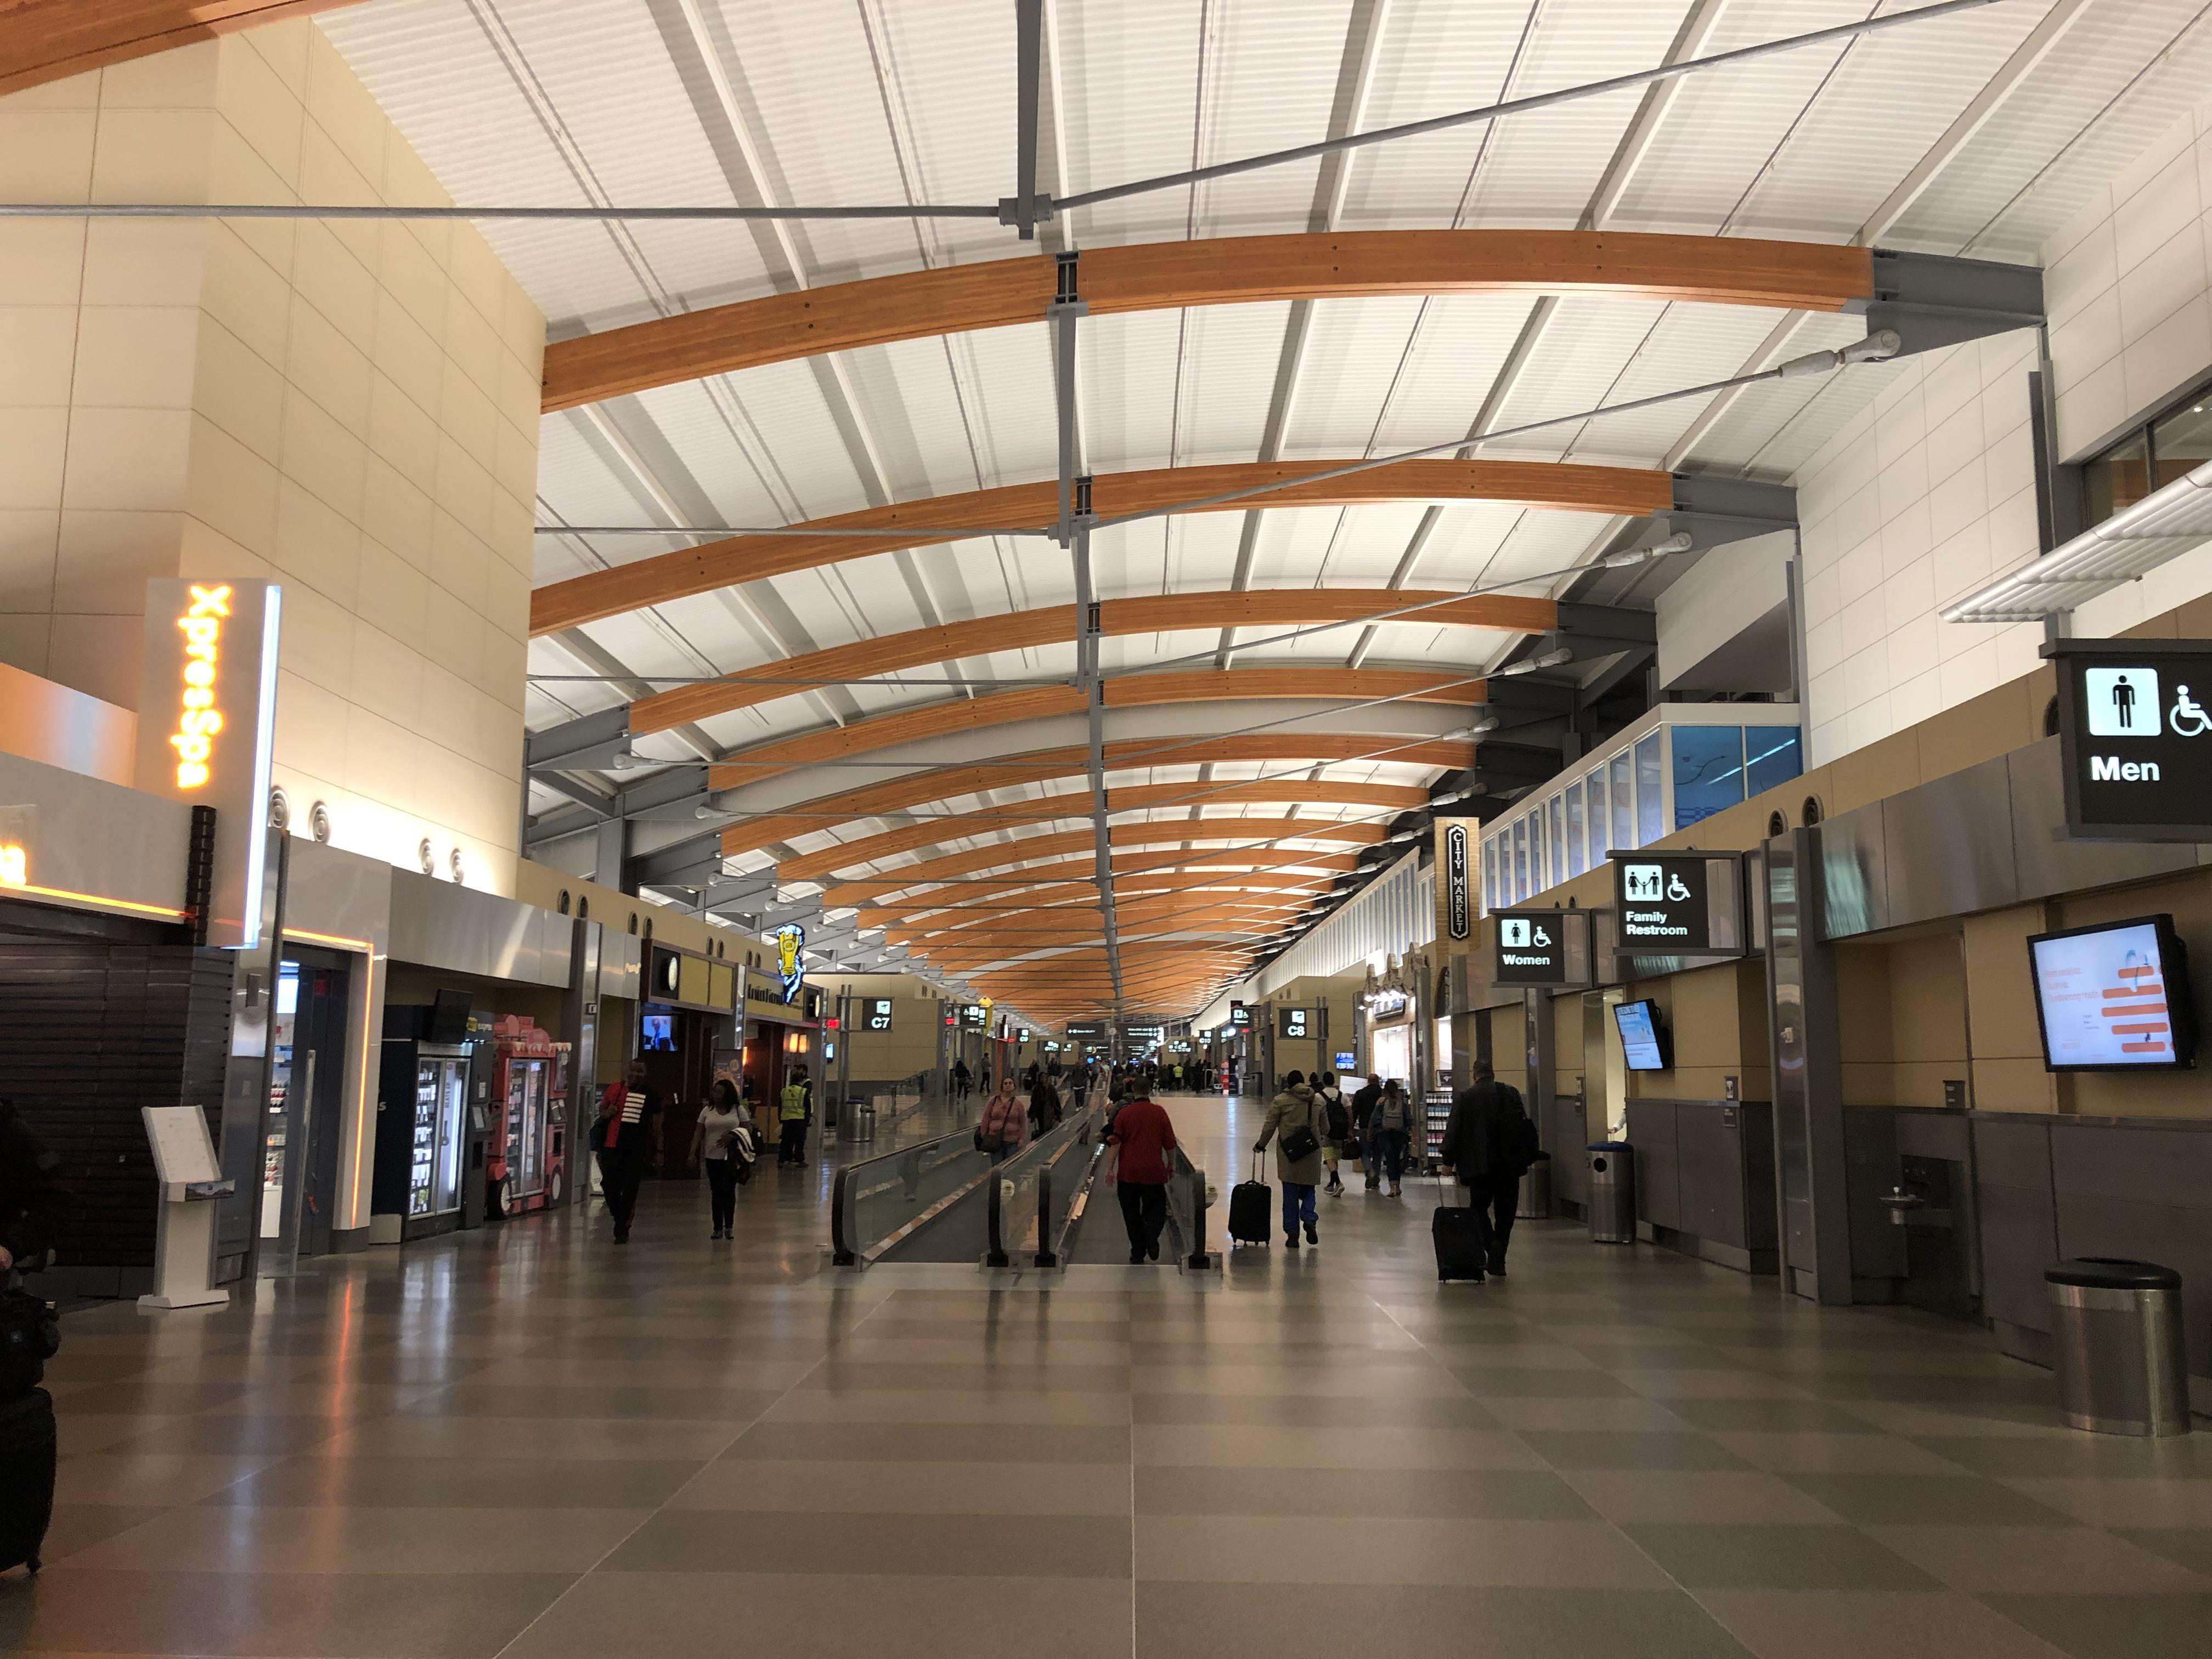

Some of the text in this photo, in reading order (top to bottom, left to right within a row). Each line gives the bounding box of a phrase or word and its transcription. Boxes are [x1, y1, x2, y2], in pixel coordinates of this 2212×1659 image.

[2091, 756, 2160, 781] Men
[1453, 833, 1464, 932] CITY MARKET
[1626, 911, 1667, 924] Family
[1626, 924, 1688, 935] Restroom
[1502, 954, 1550, 965] Women
[871, 1017, 890, 1029] C7
[1288, 1025, 1305, 1036] C8
